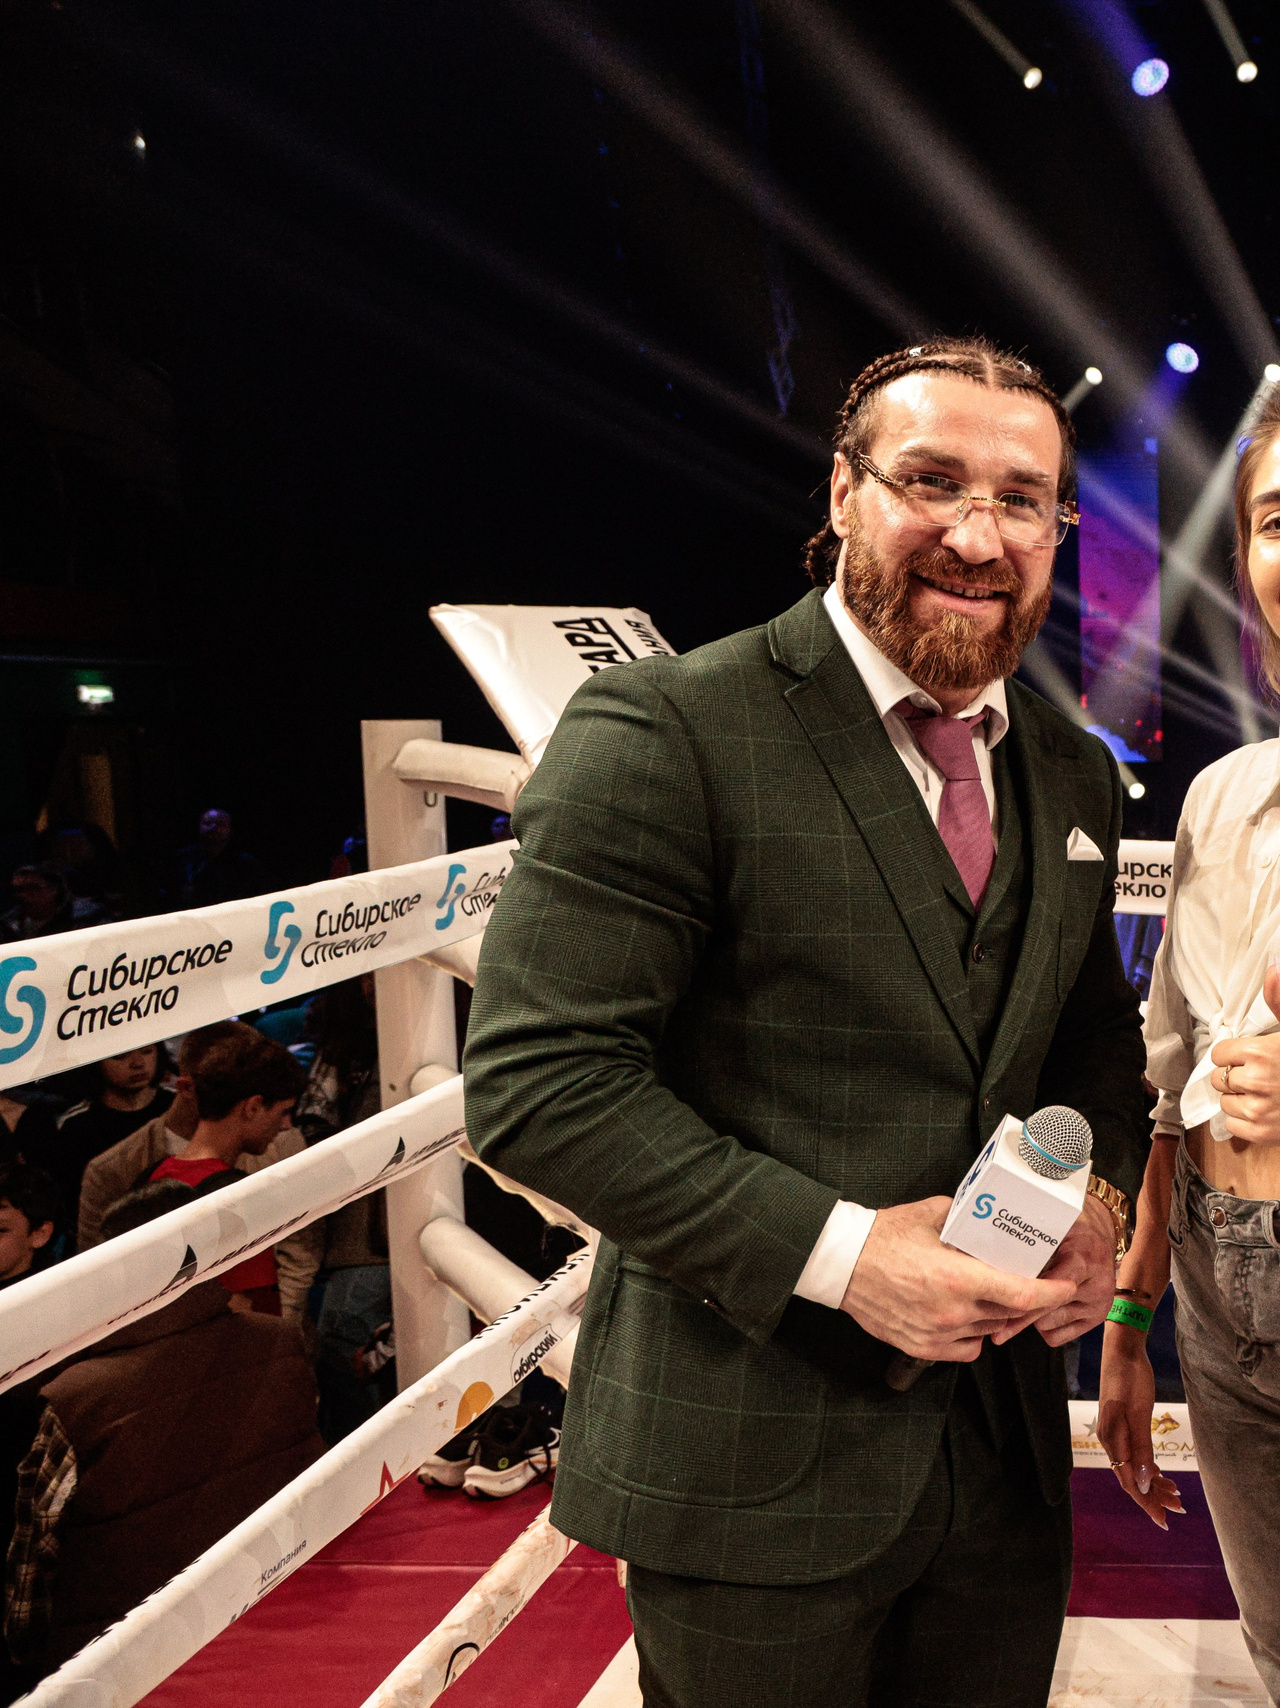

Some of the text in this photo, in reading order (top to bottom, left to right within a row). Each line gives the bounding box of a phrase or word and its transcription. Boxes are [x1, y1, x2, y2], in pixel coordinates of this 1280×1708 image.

[315, 891, 422, 939] Сибирское
[67, 938, 233, 1000] Сибирское
[300, 930, 387, 968] Стекло
[57, 984, 180, 1041] Стекло
[992, 1217, 1036, 1247] Стекло
[997, 1208, 1058, 1247] Сибирское
